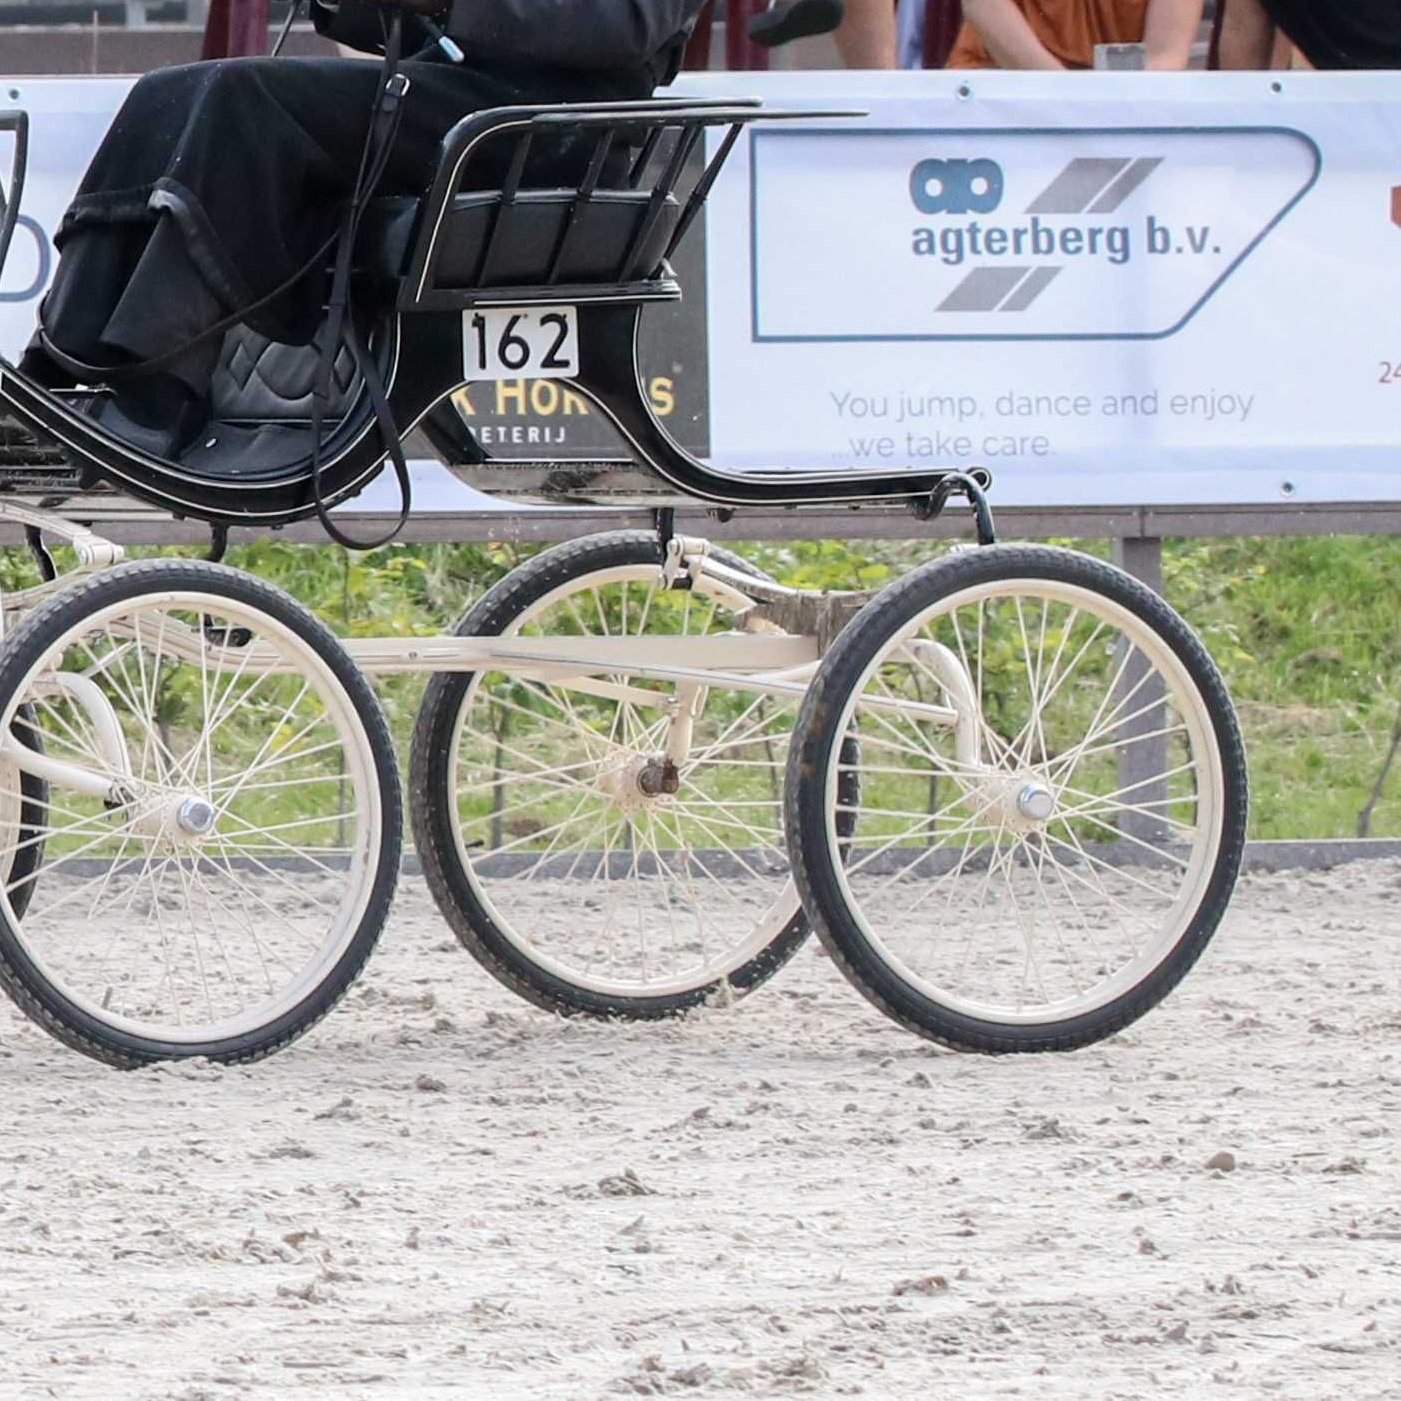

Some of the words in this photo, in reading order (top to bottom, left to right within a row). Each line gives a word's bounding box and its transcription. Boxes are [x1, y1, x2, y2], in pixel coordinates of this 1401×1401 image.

[911, 216, 1131, 266] agterberg
[1146, 215, 1222, 255] b.v.
[471, 312, 571, 371] 162
[830, 390, 888, 418] You
[896, 390, 985, 423] jump,
[995, 390, 1092, 417] dance
[1101, 389, 1159, 417] and
[1169, 388, 1256, 422] enjoy
[906, 430, 973, 458] take
[982, 435, 1057, 459] care.
